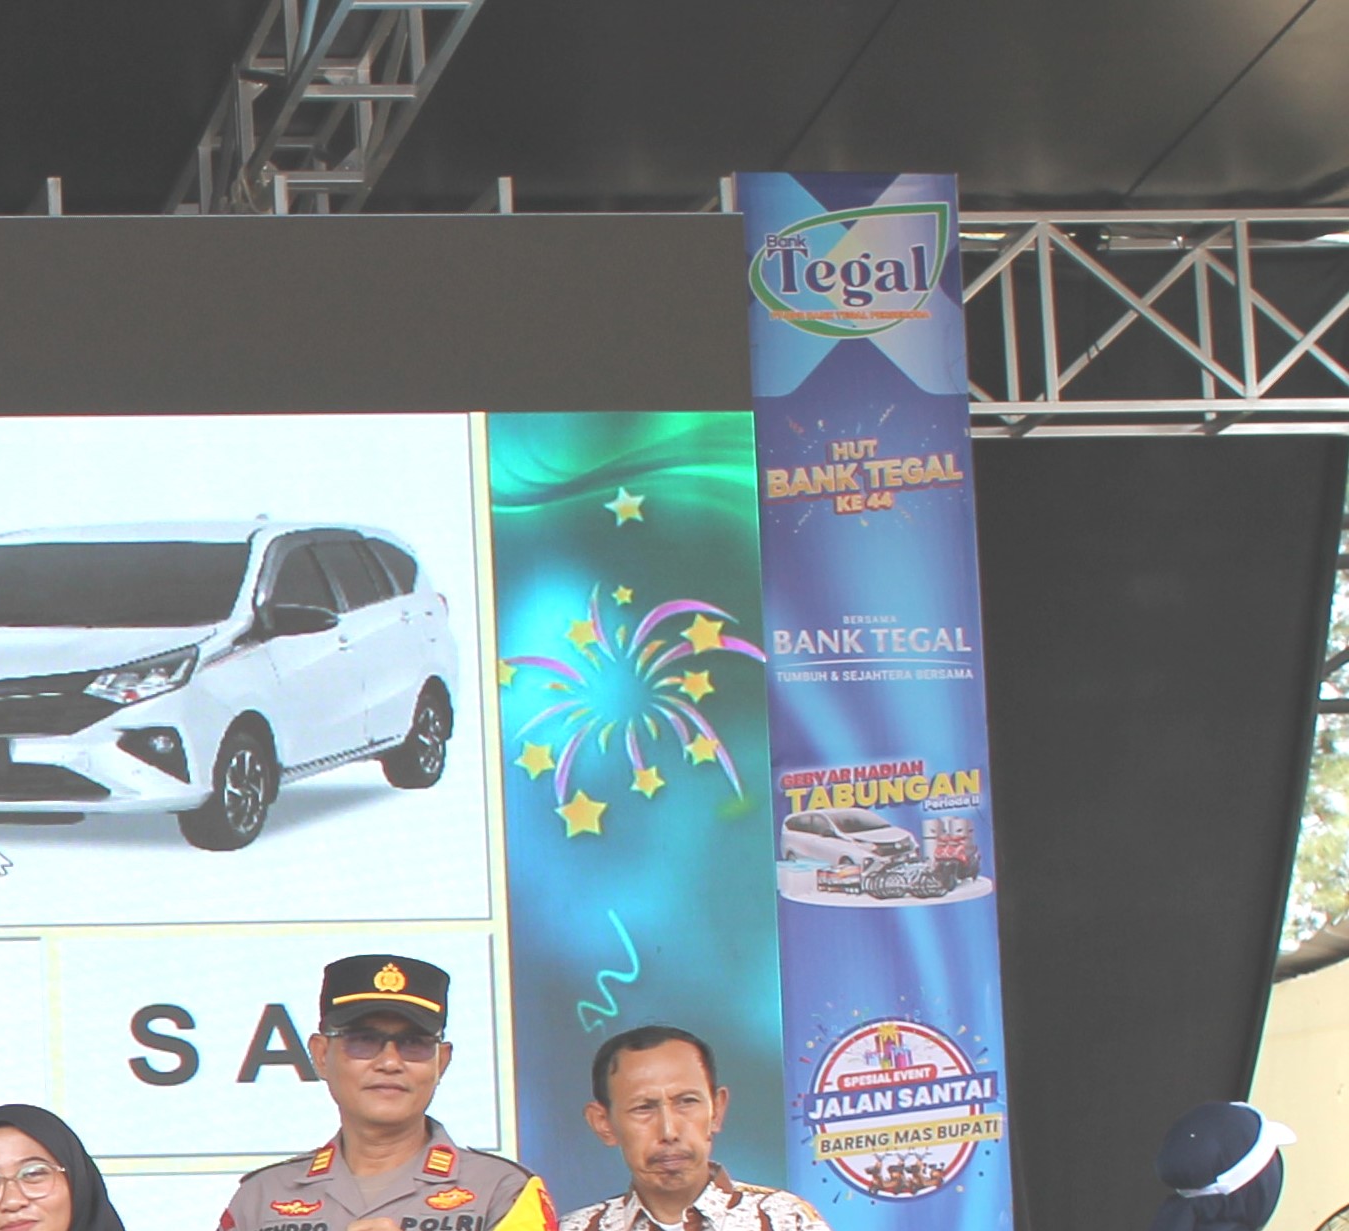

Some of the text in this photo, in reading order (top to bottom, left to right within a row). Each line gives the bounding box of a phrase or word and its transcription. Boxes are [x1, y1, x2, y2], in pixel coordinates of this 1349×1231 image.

[765, 234, 807, 249] Bank
[765, 245, 930, 307] Tegal
[832, 440, 878, 462] HUT
[766, 454, 964, 498] BANK TEGAL
[836, 491, 894, 513] KE 44
[773, 627, 972, 655] BANK TEGAL
[776, 671, 828, 683] TUMBUH
[842, 670, 913, 682] SEJAHTERA
[916, 669, 974, 681] BERSAMA
[854, 760, 924, 782] HADIAH
[785, 769, 981, 814] TABUNGAN
[128, 1003, 200, 1087] S
[843, 1067, 932, 1088] SPESIAL EVENT
[808, 1078, 992, 1120] JALAN SANTAI
[820, 1120, 999, 1153] BARENG MAS BUPATI
